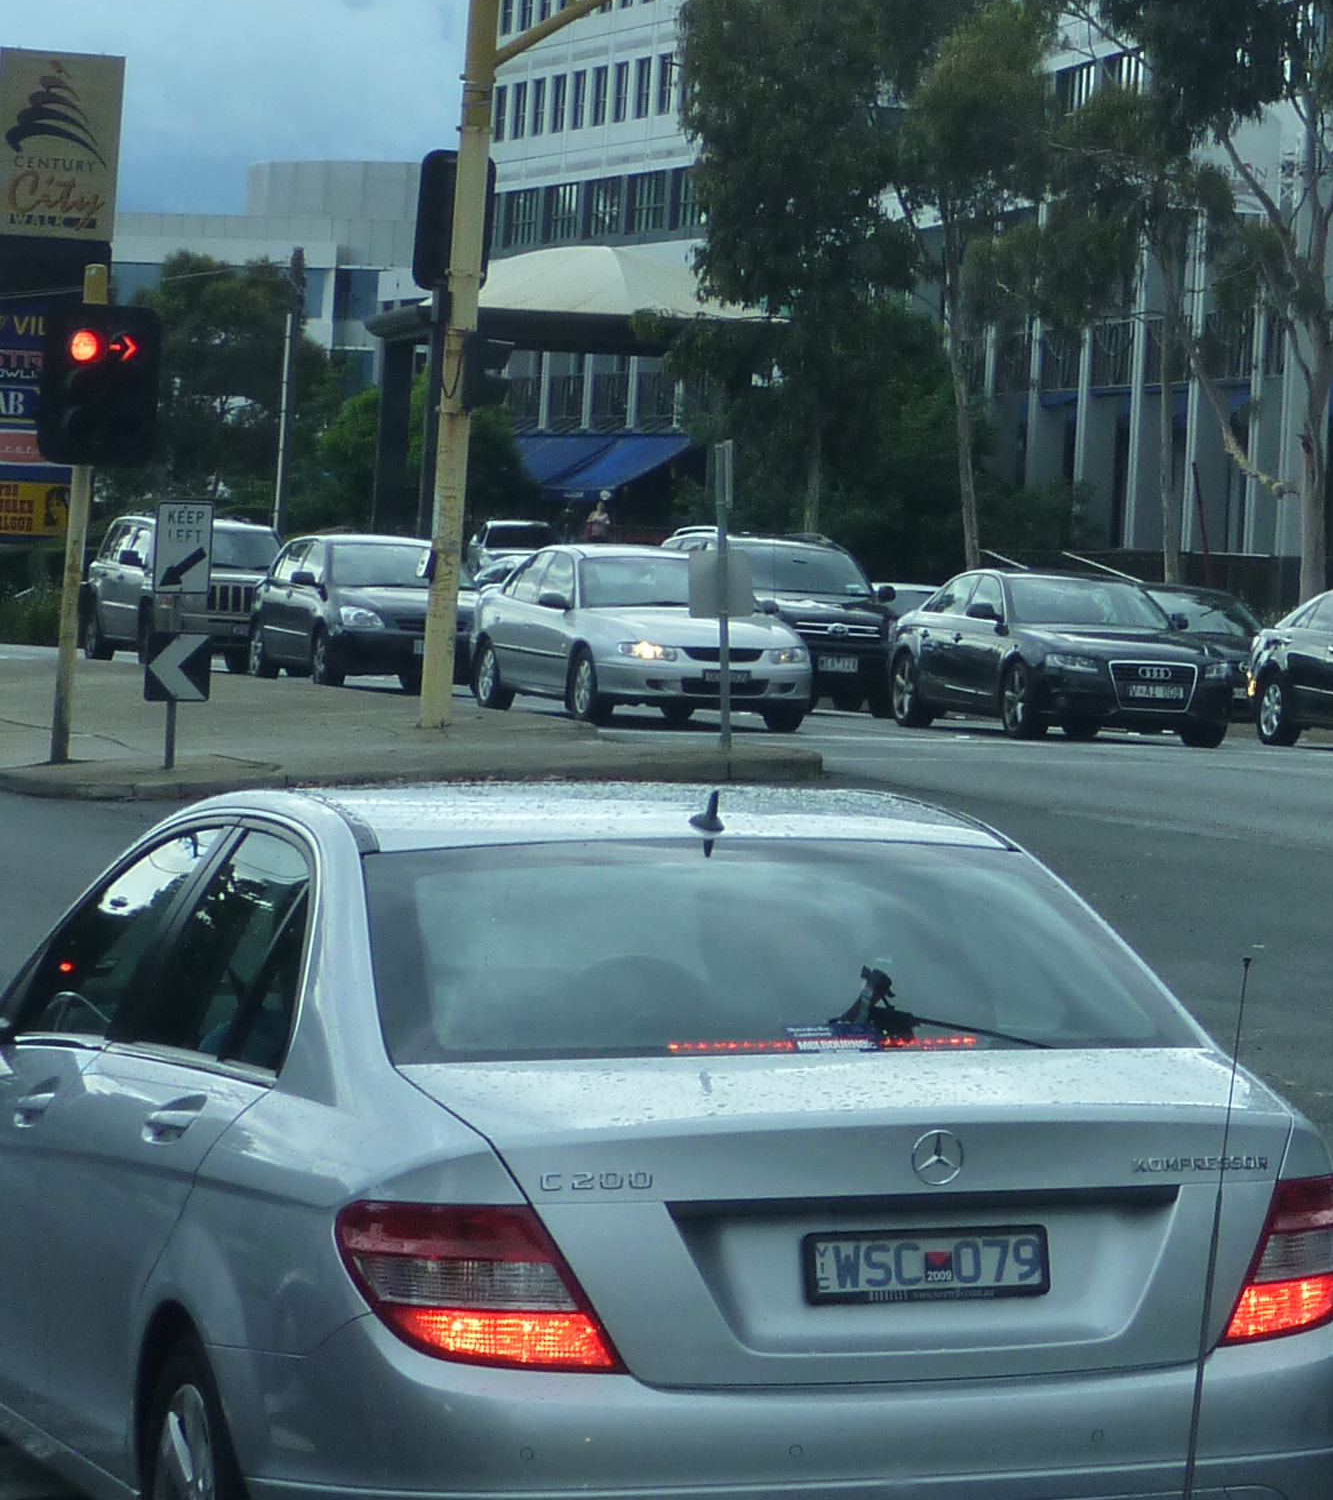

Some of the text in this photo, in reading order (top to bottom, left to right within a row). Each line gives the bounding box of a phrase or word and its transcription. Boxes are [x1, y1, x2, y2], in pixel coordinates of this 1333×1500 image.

[14, 156, 96, 172] CENTURY
[8, 169, 105, 231] City
[168, 510, 204, 524] KEEP
[168, 530, 202, 543] LEFT
[1132, 1156, 1268, 1173] KOMPRESSOR
[540, 1170, 653, 1192] C 200
[834, 1238, 1042, 1289] WSC 2009 079
